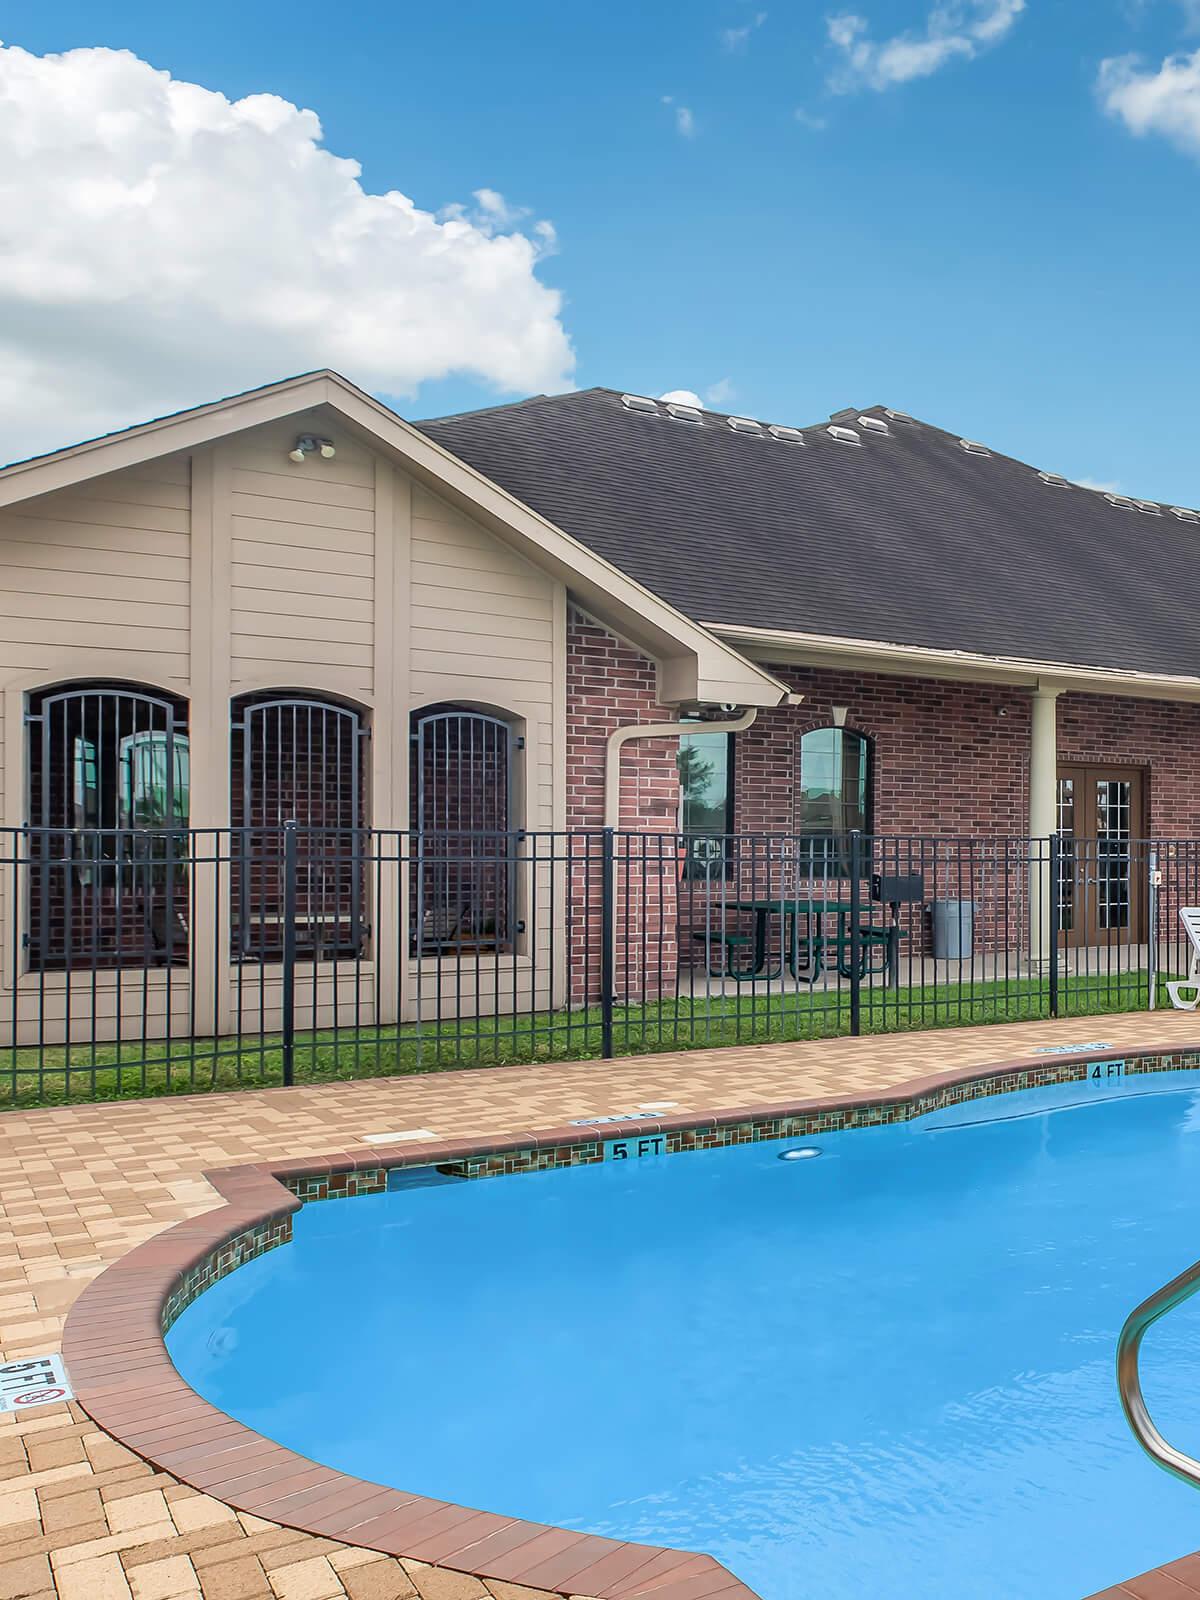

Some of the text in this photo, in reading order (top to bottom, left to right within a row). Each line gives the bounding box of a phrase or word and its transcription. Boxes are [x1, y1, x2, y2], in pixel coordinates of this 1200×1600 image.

[1092, 1063, 1123, 1079] 4 FT
[612, 1138, 663, 1160] 5 FT
[1, 1371, 56, 1391] FT
